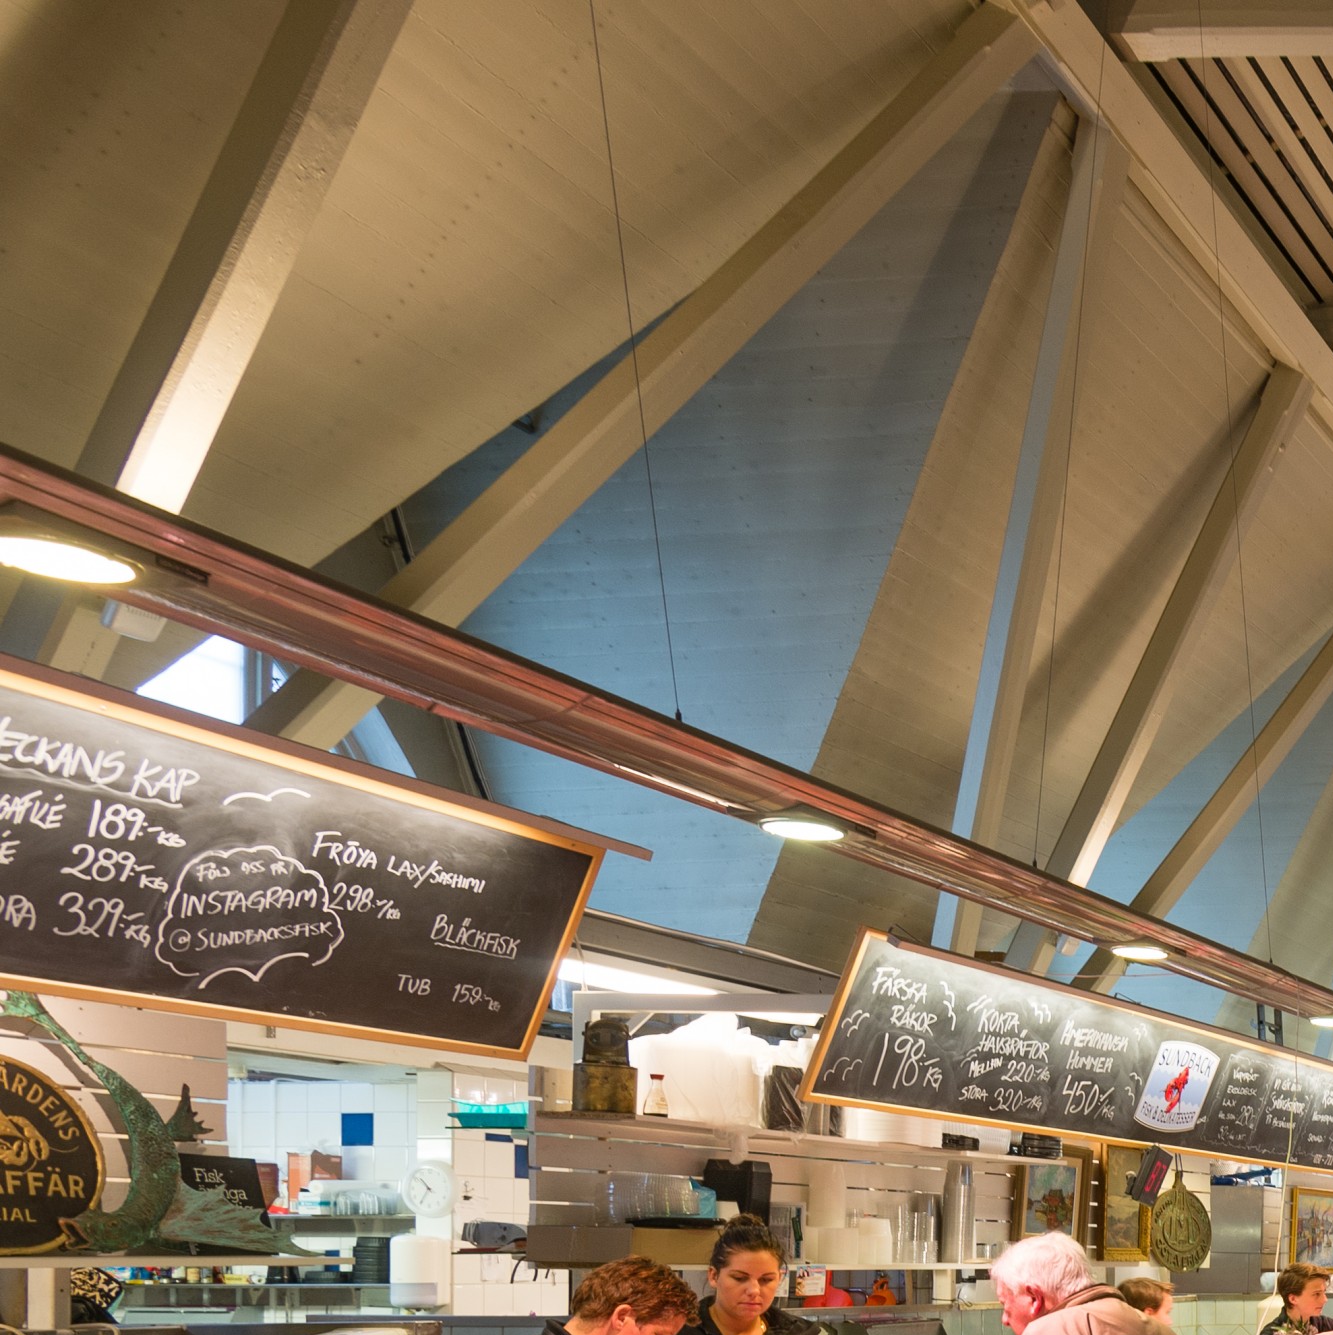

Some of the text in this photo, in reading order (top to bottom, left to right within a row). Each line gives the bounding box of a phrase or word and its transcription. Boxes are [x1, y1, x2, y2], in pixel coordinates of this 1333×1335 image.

[130, 759, 201, 802] KAP
[181, 886, 319, 918] INSTAGRAM
[397, 973, 431, 996] TUB
[890, 1004, 938, 1036] RÄKOR
[977, 1008, 1020, 1034] KOKTA
[1066, 1049, 1114, 1073] HUMMER
[1158, 1048, 1214, 1078] SUNDBACK
[958, 1084, 989, 1103] STORA
[0, 1167, 86, 1199] FFÄR
[193, 1167, 226, 1184] Fisk
